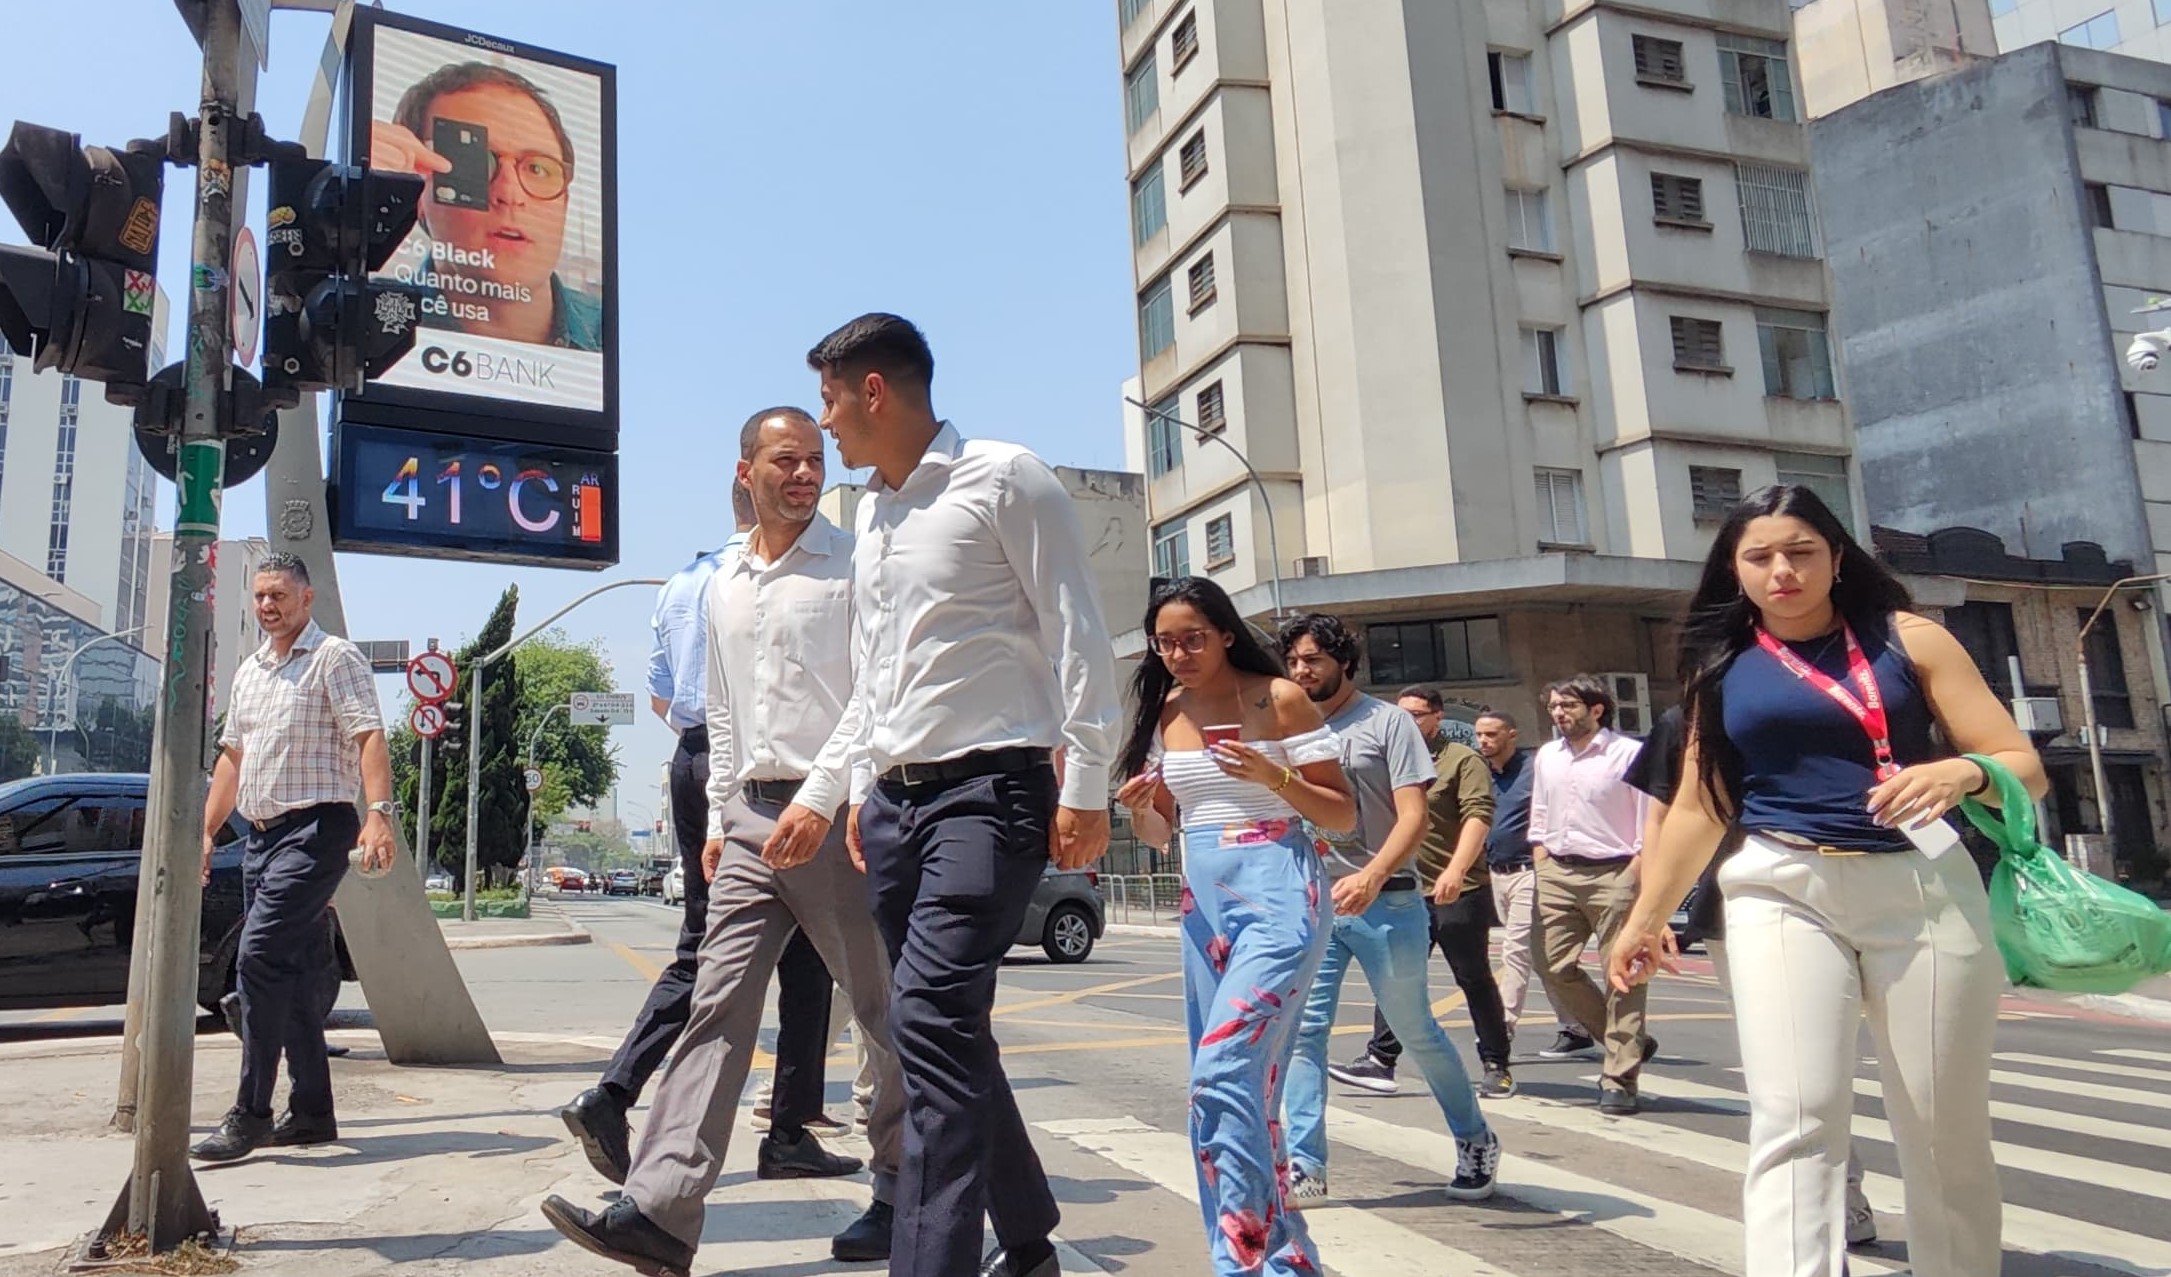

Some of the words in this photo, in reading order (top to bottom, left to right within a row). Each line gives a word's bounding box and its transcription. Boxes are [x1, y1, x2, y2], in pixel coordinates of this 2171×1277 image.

[464, 33, 515, 53] JCDecaux
[431, 241, 496, 269] Black
[395, 264, 478, 294] Quanto
[482, 282, 532, 303] mais
[420, 294, 448, 317] cê
[452, 301, 491, 322] usa
[580, 473, 600, 487] AR
[571, 483, 582, 538] RUIM
